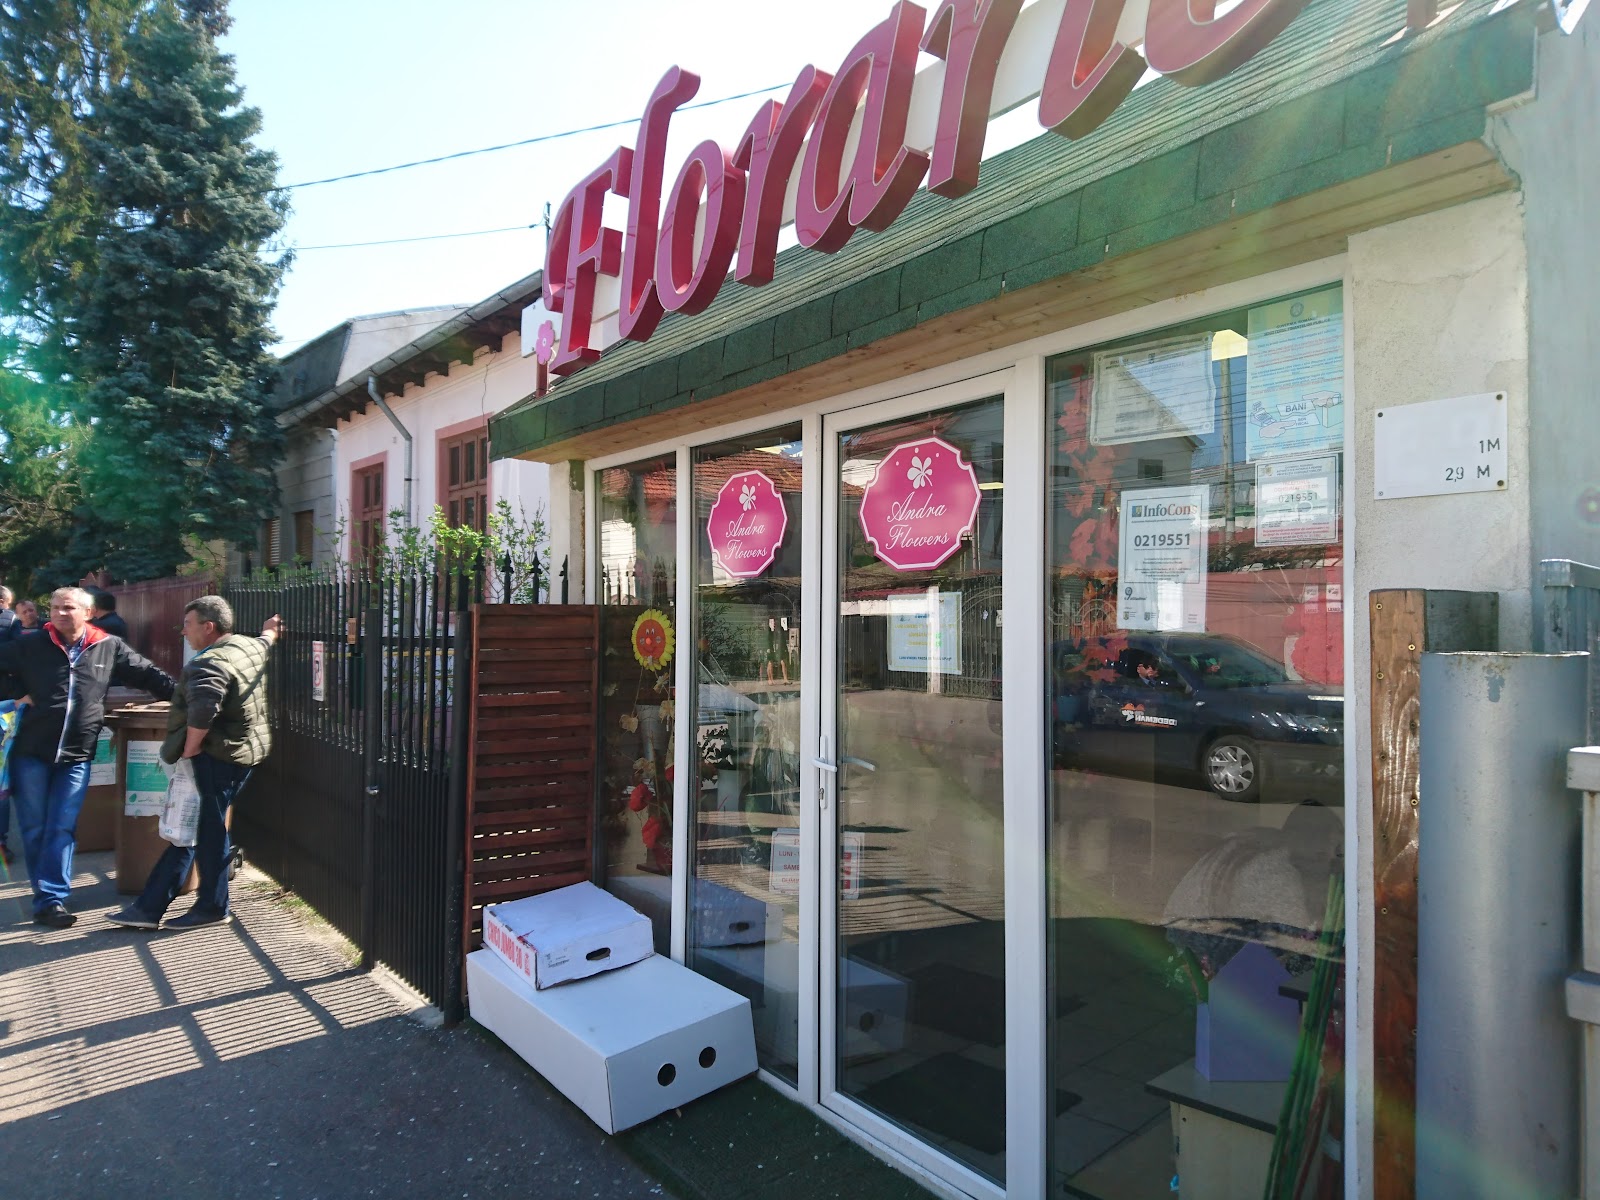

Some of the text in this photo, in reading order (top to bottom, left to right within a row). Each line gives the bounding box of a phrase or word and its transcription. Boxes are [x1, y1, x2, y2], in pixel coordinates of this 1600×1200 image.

[543, 0, 1308, 376] Florar
[1285, 403, 1307, 413] BANI
[1476, 465, 1490, 478] M
[887, 491, 947, 523] Andra
[1279, 492, 1318, 503] 0219551
[1143, 504, 1197, 517] InfoCons
[726, 513, 765, 538] Andra
[885, 524, 950, 550] Flowers
[1134, 533, 1190, 547] 0219551
[725, 539, 767, 560] Flowers
[501, 932, 515, 963] JUMBO
